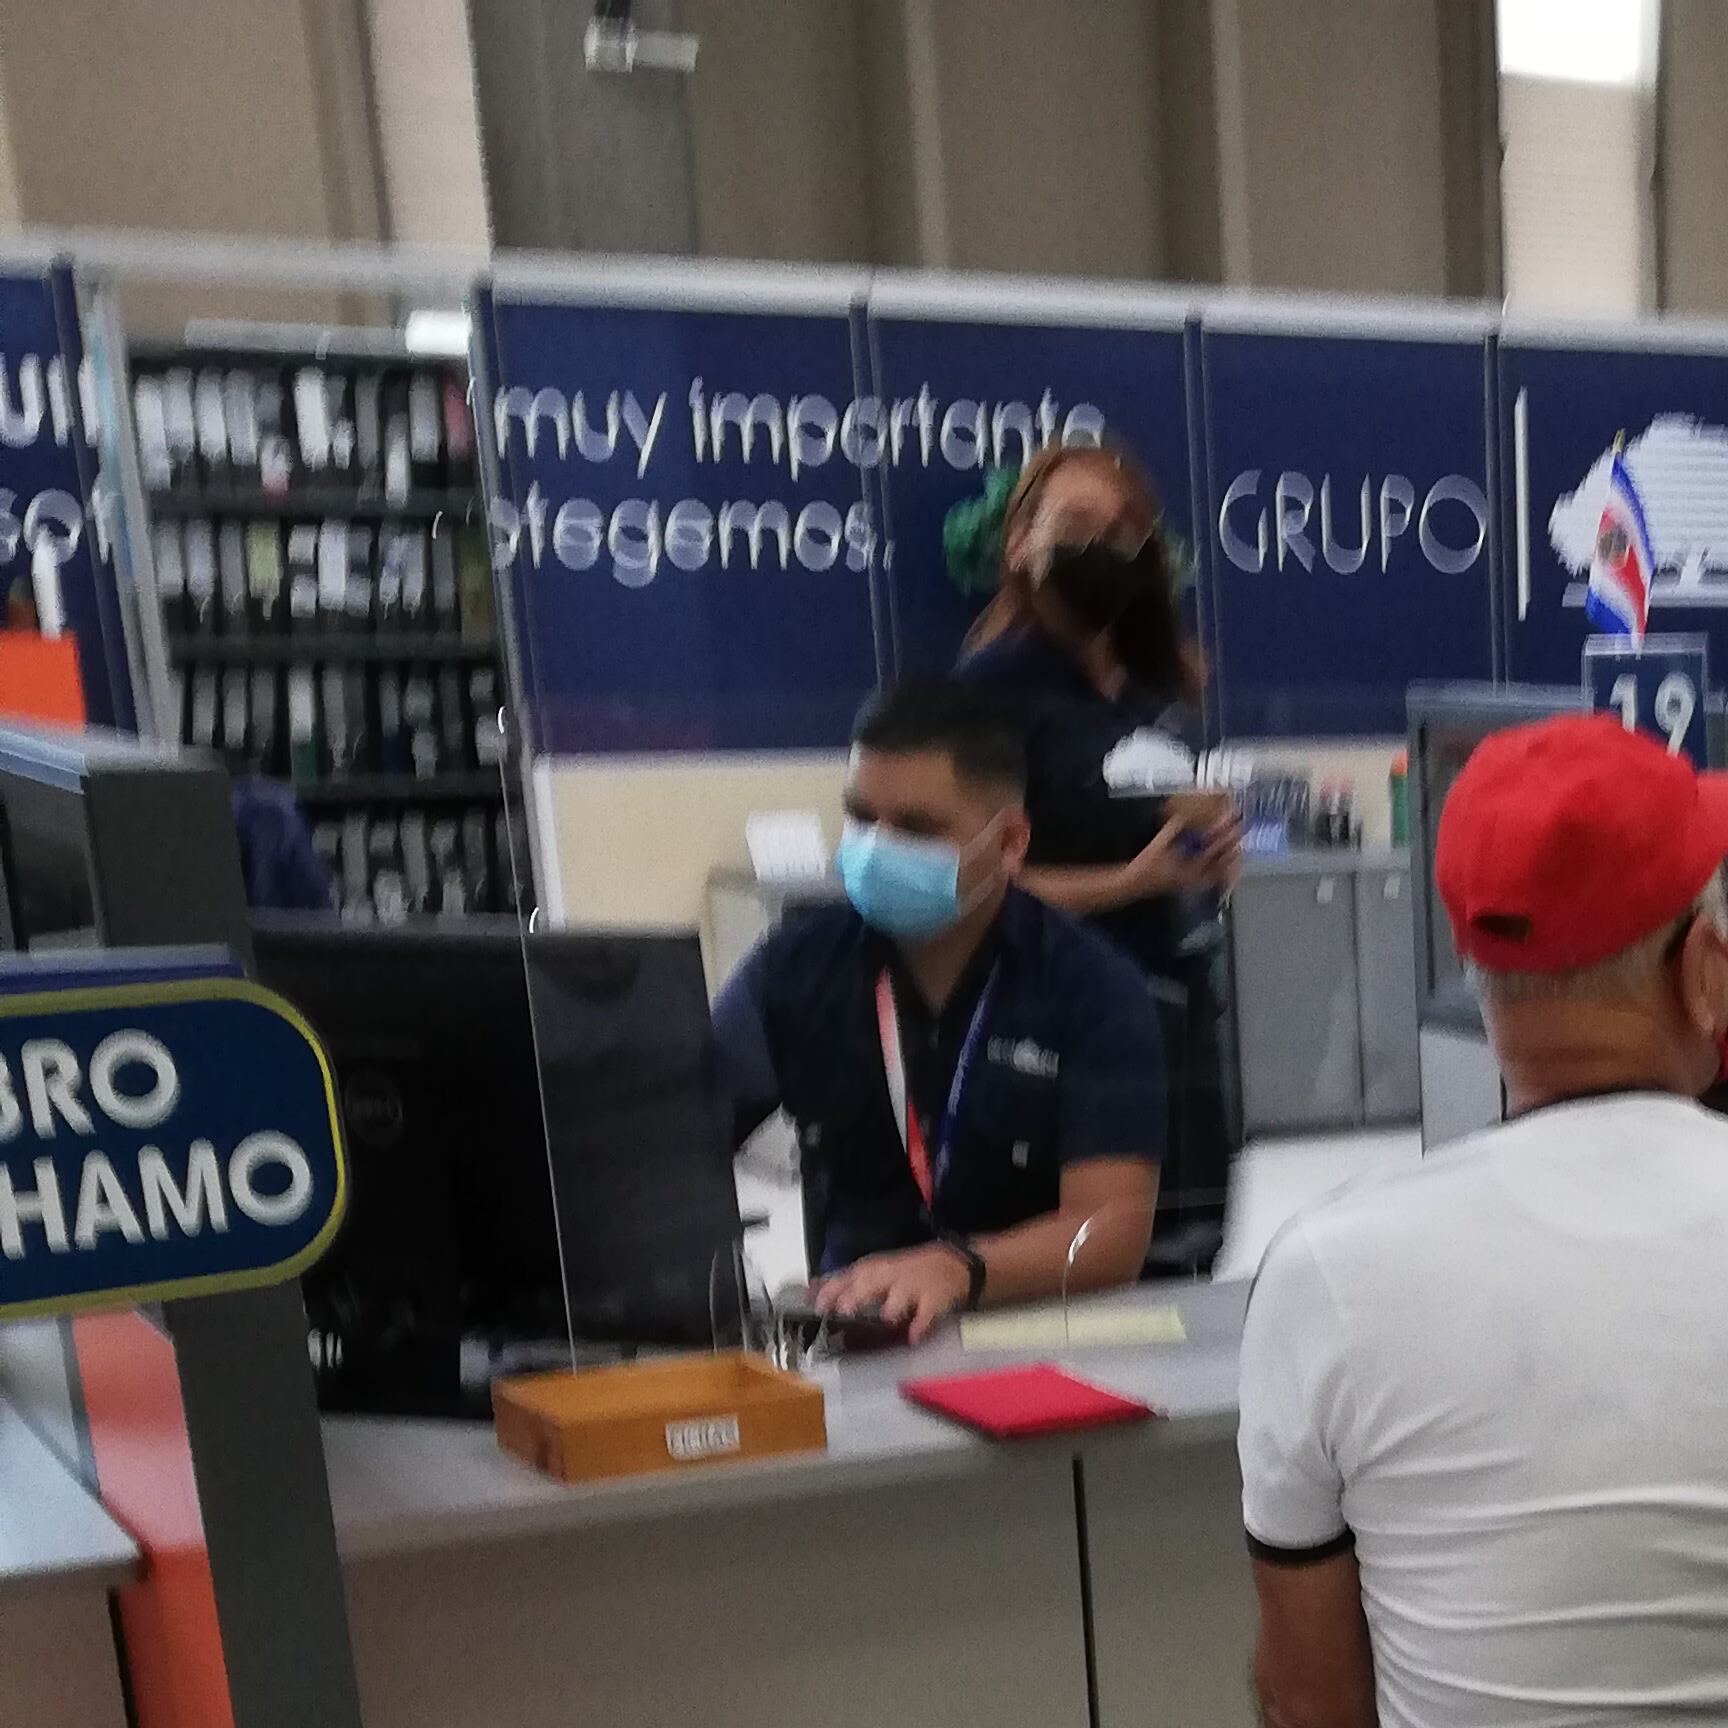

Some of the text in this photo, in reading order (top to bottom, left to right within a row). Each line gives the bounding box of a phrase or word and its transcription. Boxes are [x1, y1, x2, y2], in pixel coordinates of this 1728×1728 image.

[494, 386, 668, 480] muy
[1218, 469, 1487, 575] GRUPO
[1609, 671, 1697, 758] 19
[0, 1130, 314, 1260] HAMO
